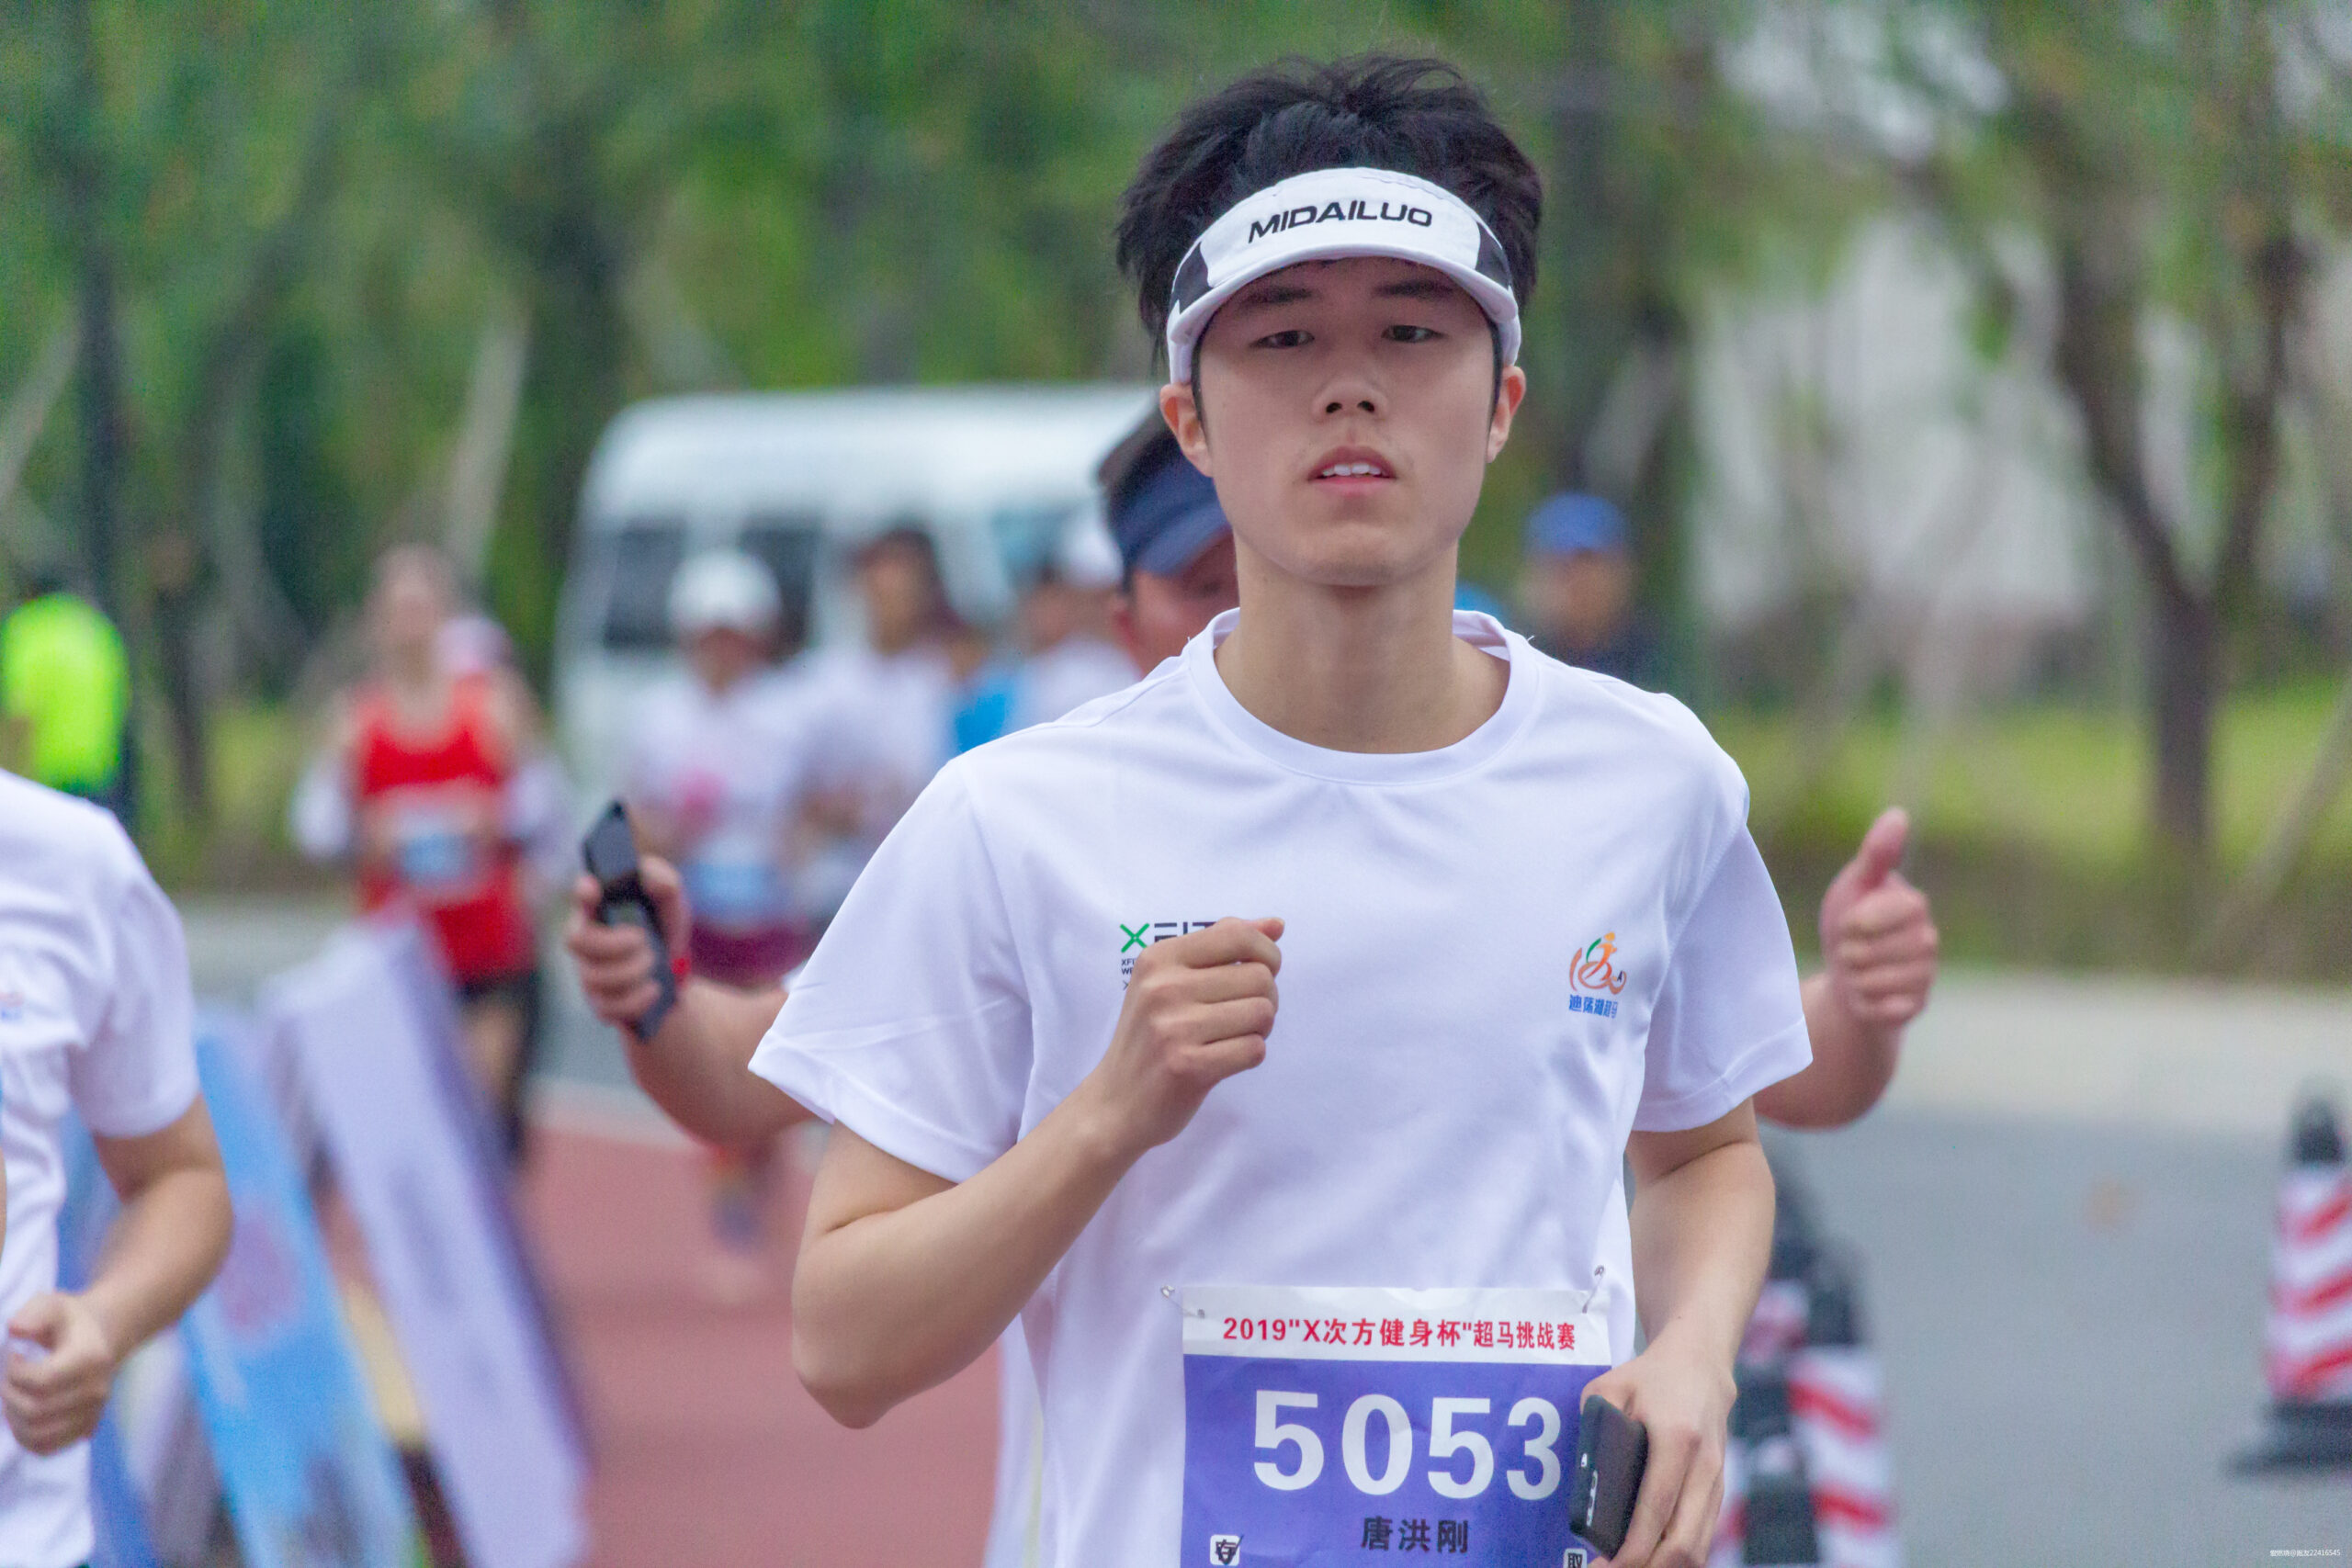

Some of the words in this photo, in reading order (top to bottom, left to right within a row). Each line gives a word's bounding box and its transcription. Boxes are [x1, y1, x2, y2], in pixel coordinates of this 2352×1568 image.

[1249, 199, 1431, 243] MIDAILUO
[1253, 1390, 1560, 1501] 5053
[1362, 1516, 1469, 1554] 唐洪刚
